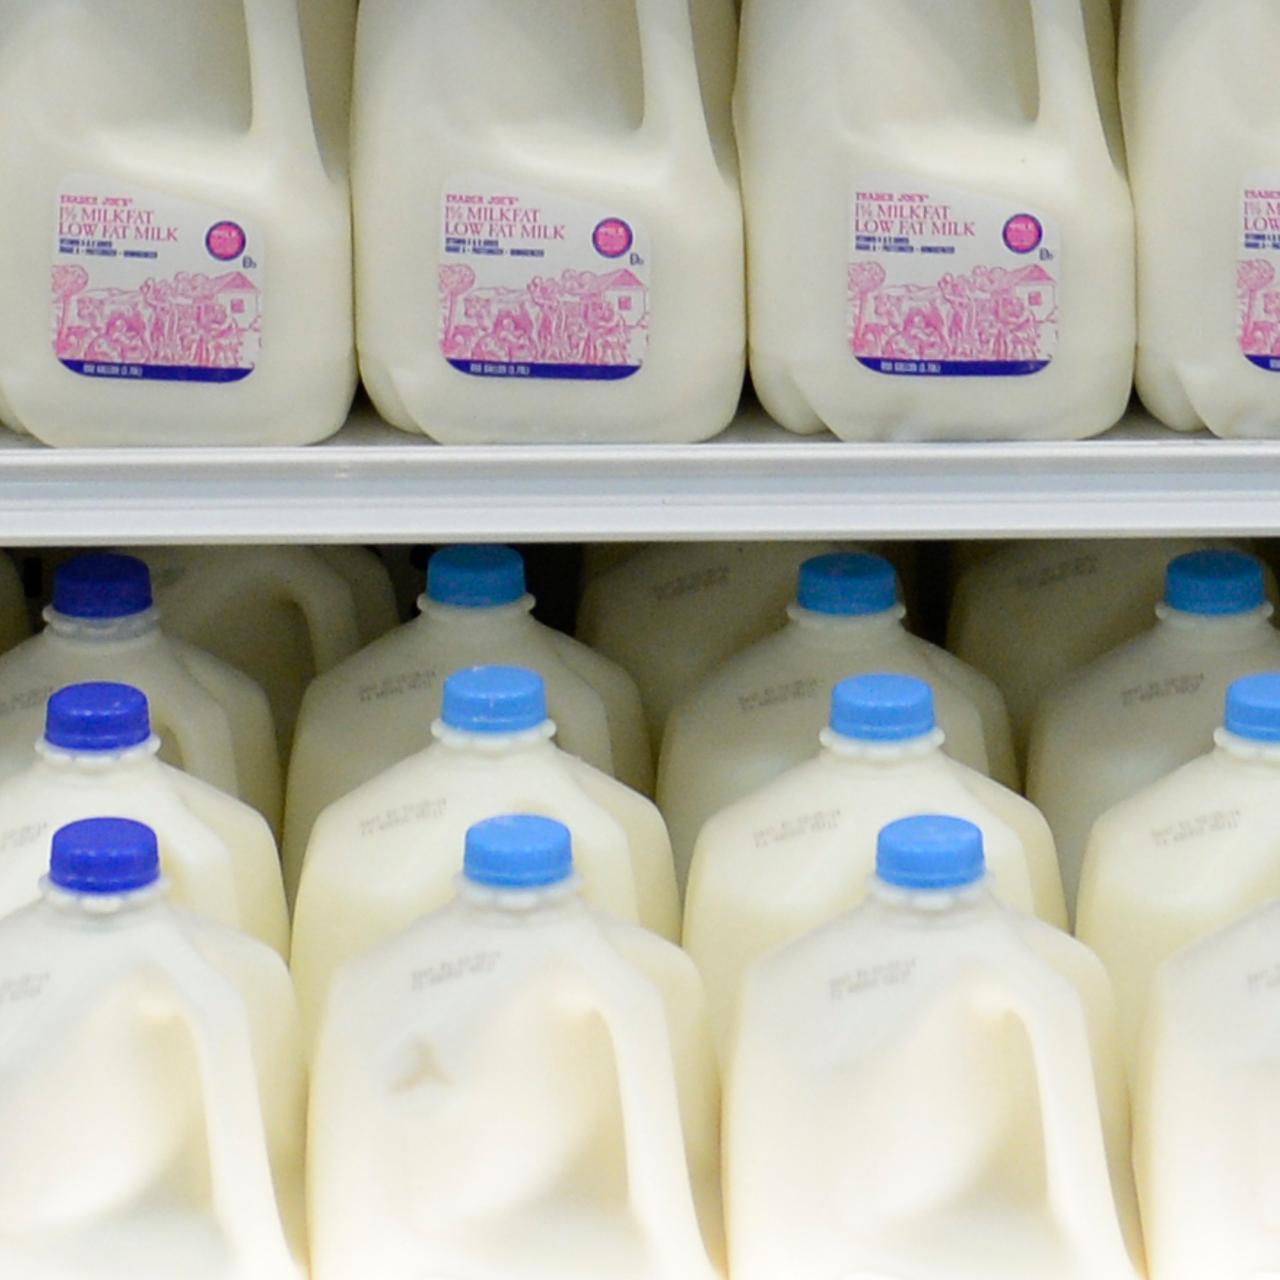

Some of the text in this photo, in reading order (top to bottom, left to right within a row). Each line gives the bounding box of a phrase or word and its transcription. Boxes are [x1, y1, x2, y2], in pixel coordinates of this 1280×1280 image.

[81, 208, 155, 225] MILKFAT
[58, 222, 180, 242] LOW FAT MILK
